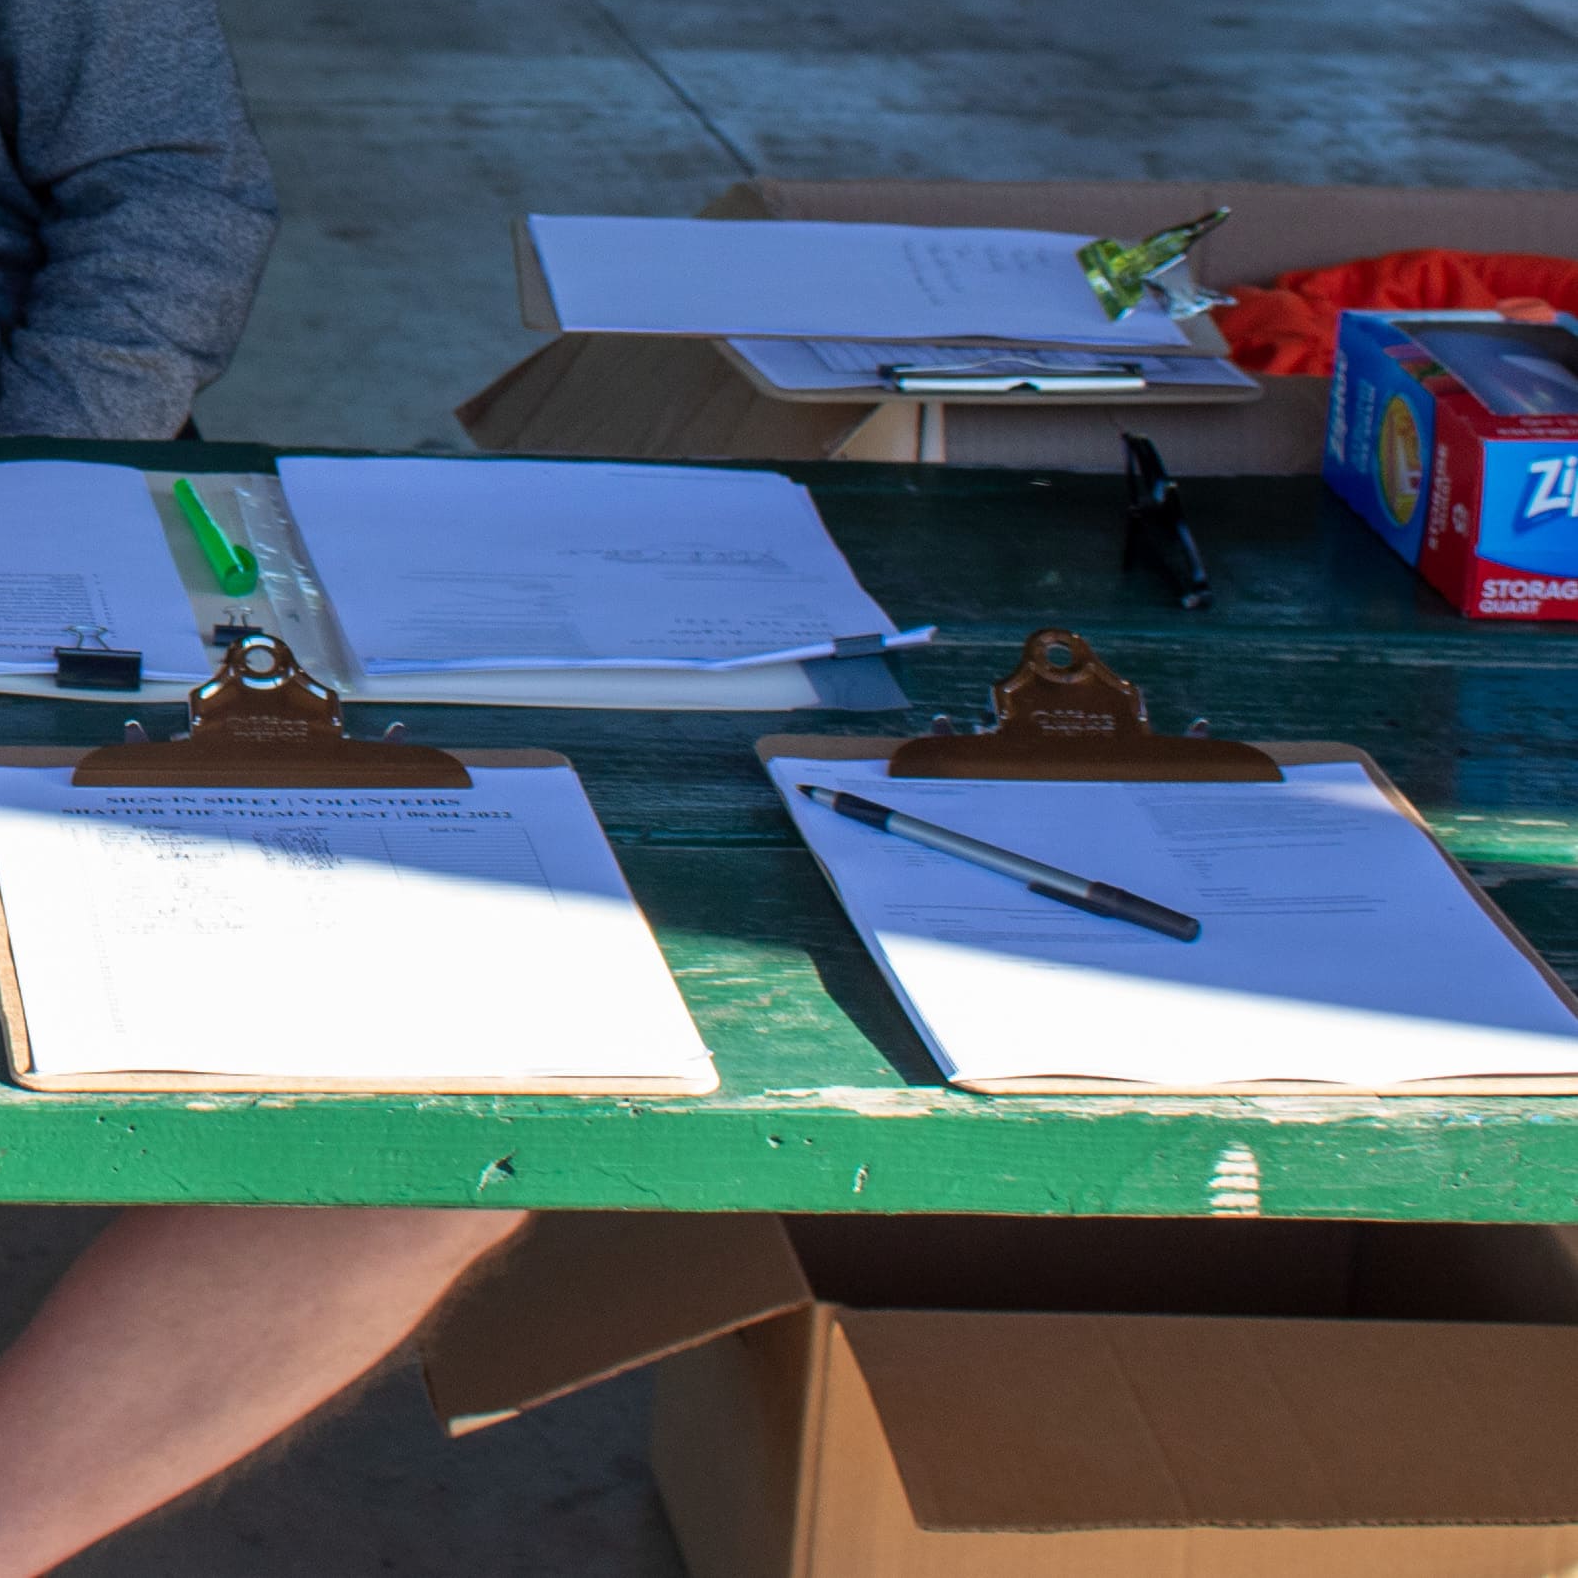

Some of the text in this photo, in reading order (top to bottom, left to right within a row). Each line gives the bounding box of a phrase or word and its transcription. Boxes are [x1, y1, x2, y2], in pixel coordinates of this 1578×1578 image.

[106, 796, 196, 804] SIGN-IN
[204, 797, 279, 805] SHEET
[299, 797, 461, 807] VOLUNTEERS
[62, 808, 165, 816] SHATTER
[175, 808, 214, 817] THE
[222, 809, 311, 818] STIGMA
[316, 810, 390, 819] EVENT
